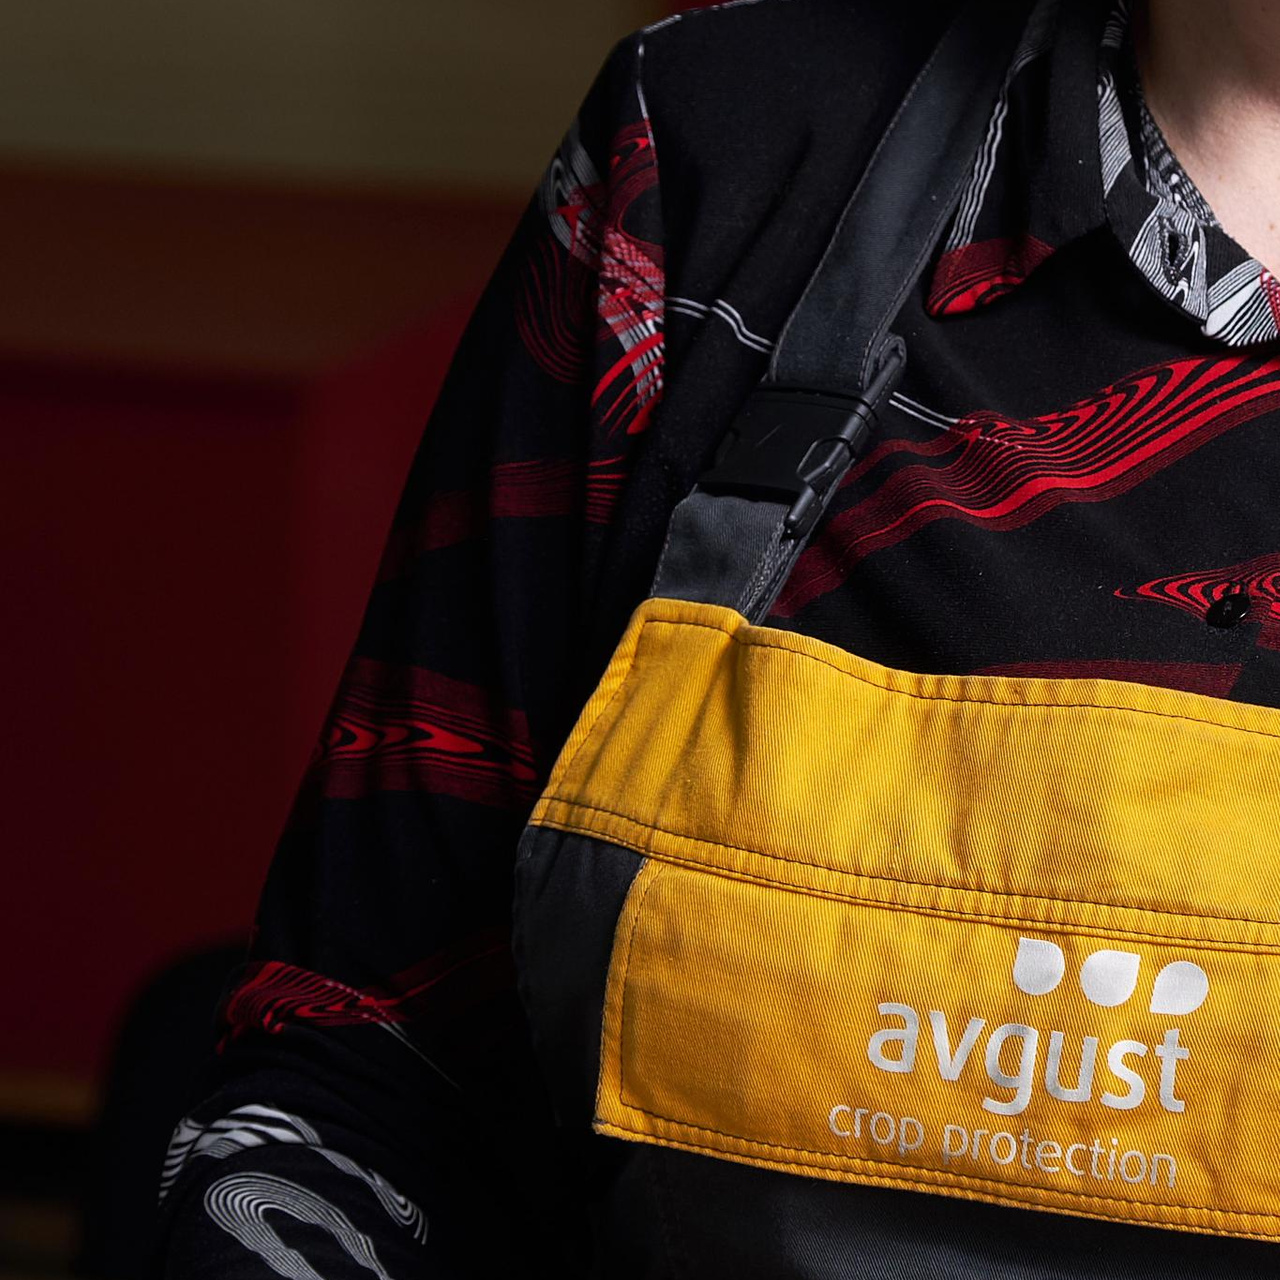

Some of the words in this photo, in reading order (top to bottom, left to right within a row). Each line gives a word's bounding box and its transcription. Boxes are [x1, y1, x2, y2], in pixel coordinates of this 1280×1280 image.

[866, 1001, 1190, 1116] avgust
[828, 1104, 925, 1156] crop
[941, 1123, 1178, 1189] protection
